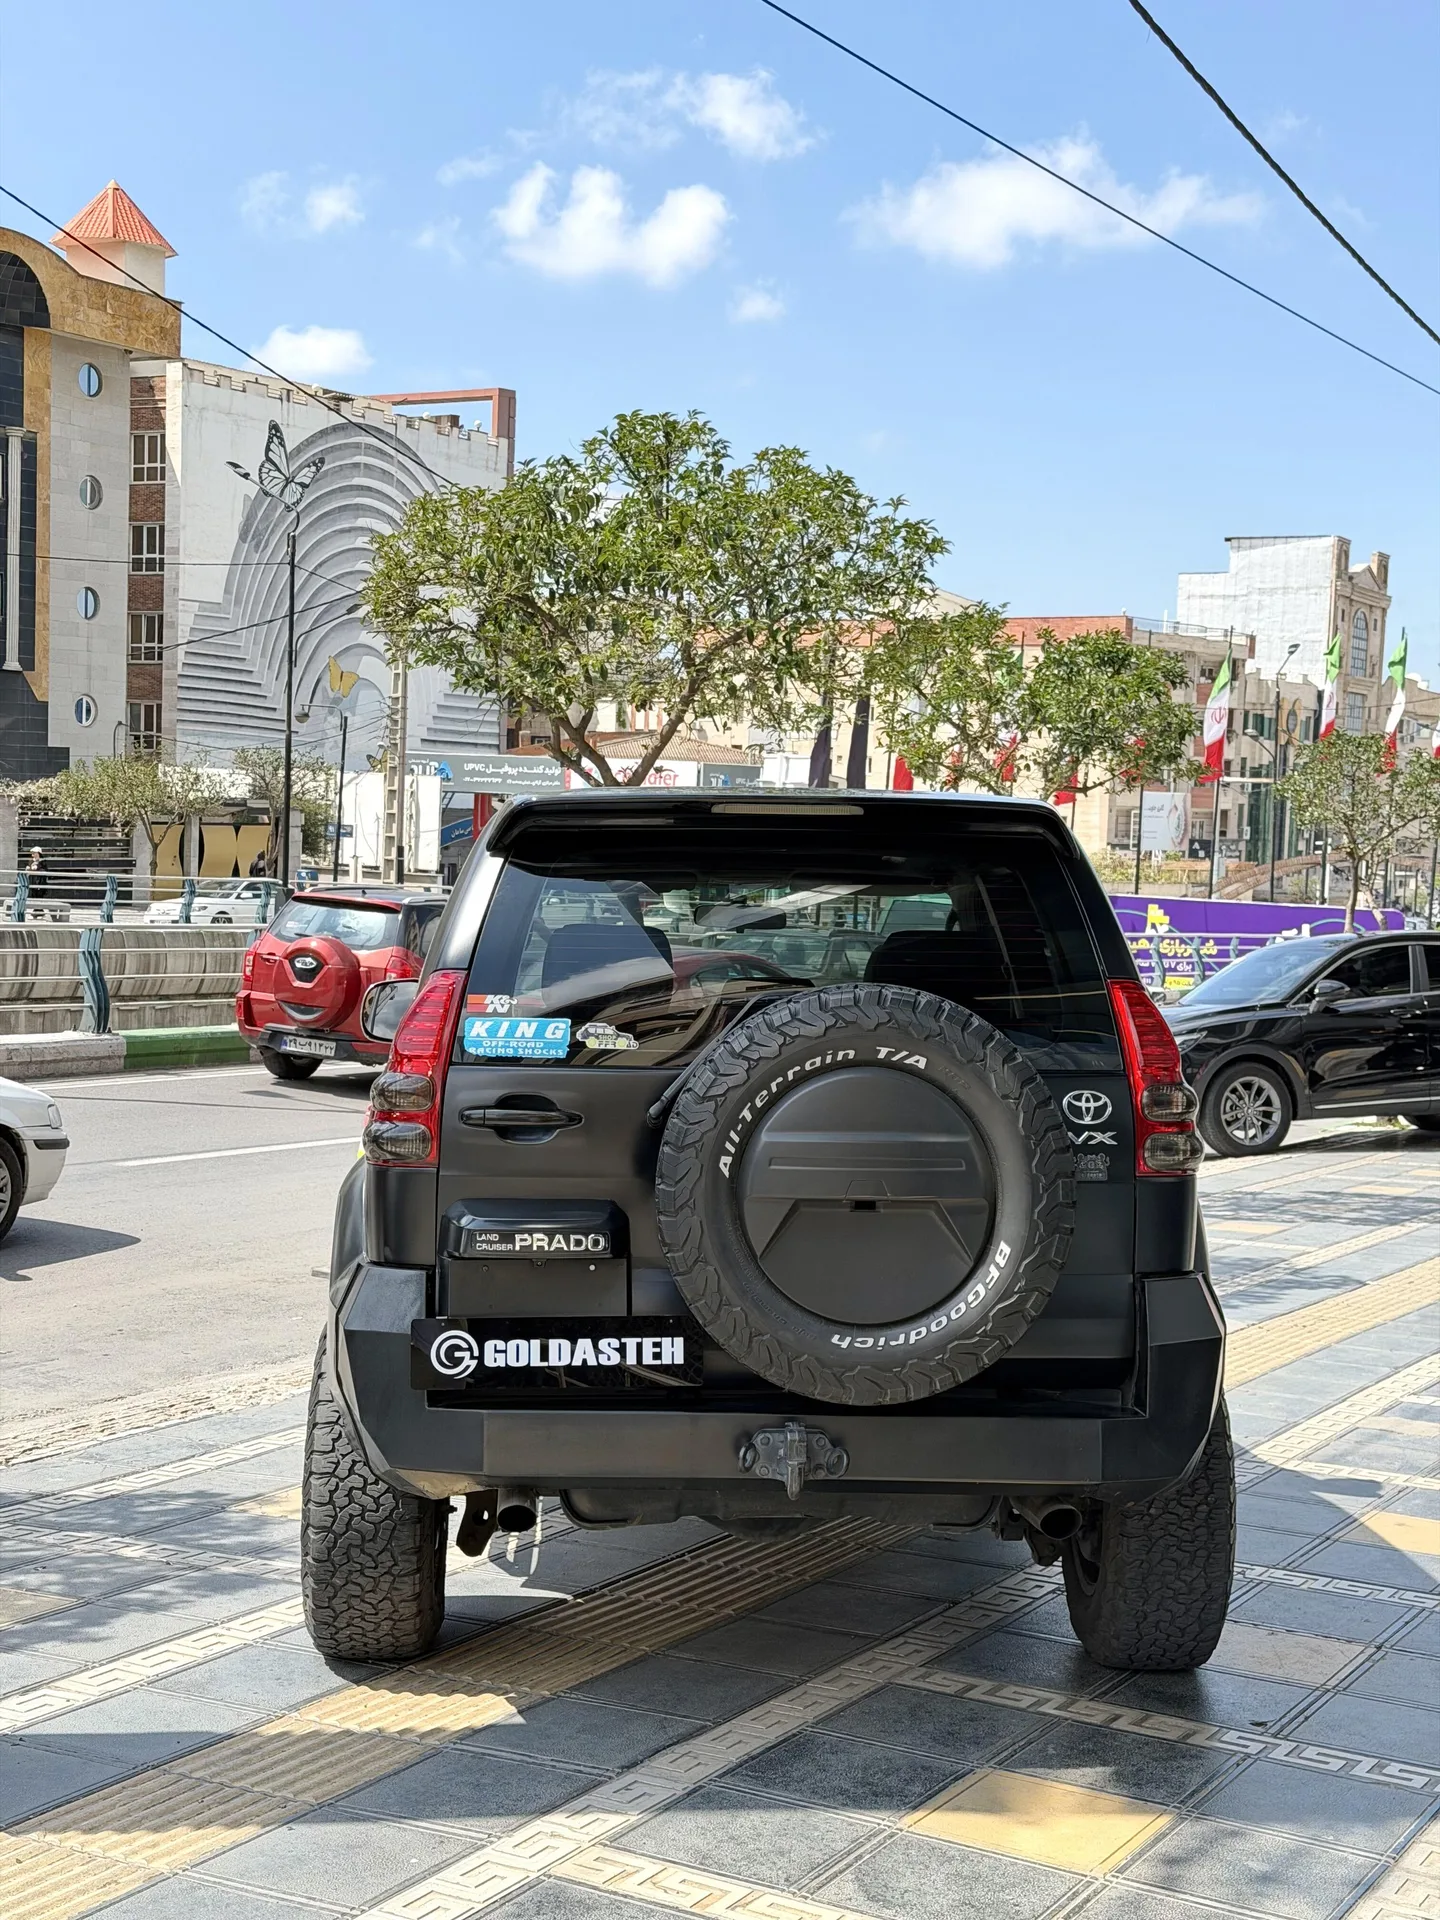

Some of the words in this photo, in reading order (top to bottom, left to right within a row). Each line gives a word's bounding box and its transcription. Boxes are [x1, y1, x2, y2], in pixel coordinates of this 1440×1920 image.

[463, 762, 486, 772] UPVC
[486, 762, 519, 776] پروفیل
[484, 994, 518, 1013] K&N
[469, 1020, 567, 1039] KING
[482, 1040, 544, 1048] OFF-ROAD
[468, 1047, 514, 1055] RACING
[518, 1048, 564, 1056] SHOCKS
[718, 1047, 856, 1179] All-Terrain
[875, 1045, 929, 1071] T/A
[1067, 1131, 1118, 1145] VX
[476, 1233, 499, 1242] LAND
[514, 1233, 606, 1251] PRADO
[476, 1242, 514, 1251] CRUISER
[830, 1239, 1013, 1351] BFGoodrich
[484, 1336, 685, 1368] GOLDASTEH
